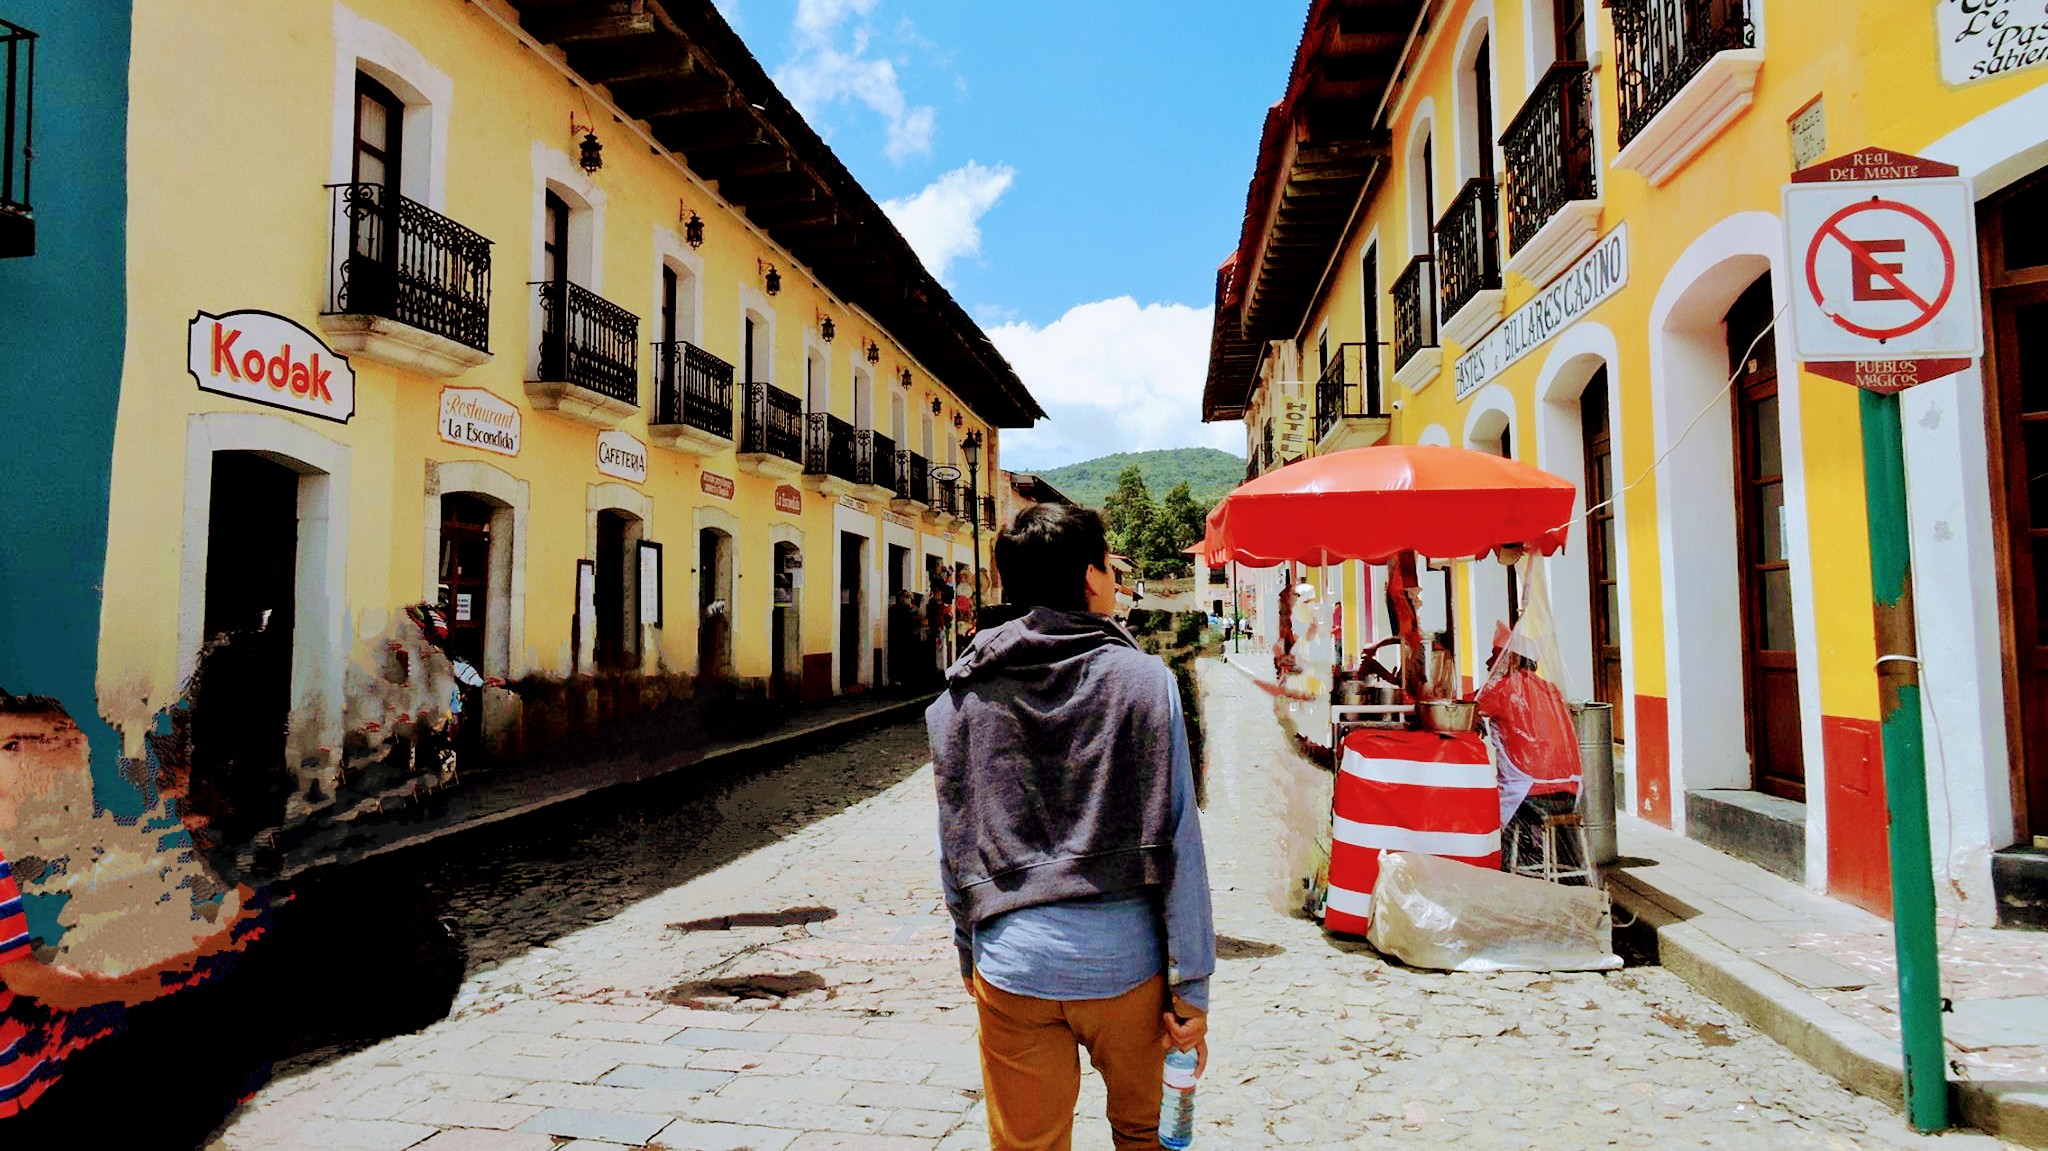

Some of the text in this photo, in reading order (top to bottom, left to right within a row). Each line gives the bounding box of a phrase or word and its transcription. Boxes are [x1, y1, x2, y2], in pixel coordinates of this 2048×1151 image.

[1955, 10, 2009, 43] Le
[1563, 235, 1621, 318] CASINO
[211, 321, 333, 405] Kodak
[445, 393, 515, 429] Restaurant
[1280, 402, 1307, 454] HOTEL
[598, 441, 645, 473] CAFETERIA
